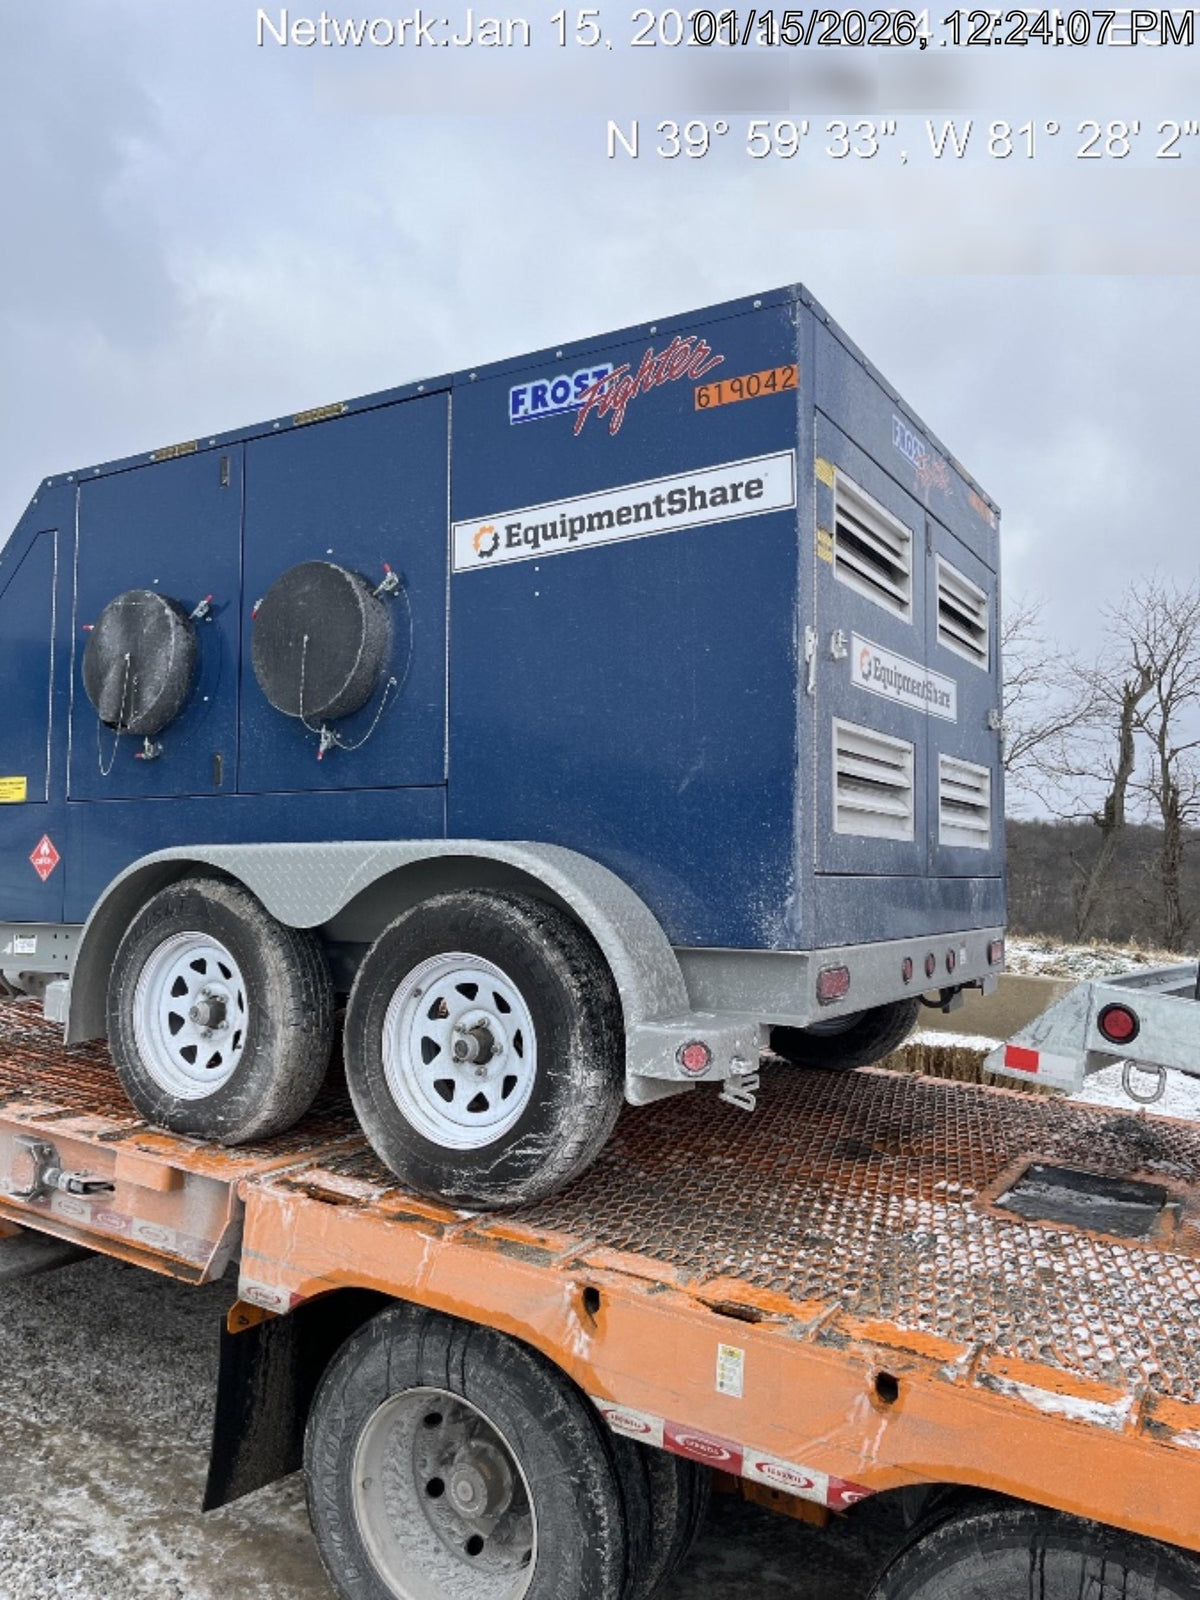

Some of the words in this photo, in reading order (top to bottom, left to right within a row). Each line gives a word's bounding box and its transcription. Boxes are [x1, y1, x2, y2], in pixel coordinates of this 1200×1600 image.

[510, 367, 613, 419] FROST
[572, 335, 726, 436] Fighter
[697, 366, 798, 409] 619042
[505, 476, 765, 550] EquipmentShare
